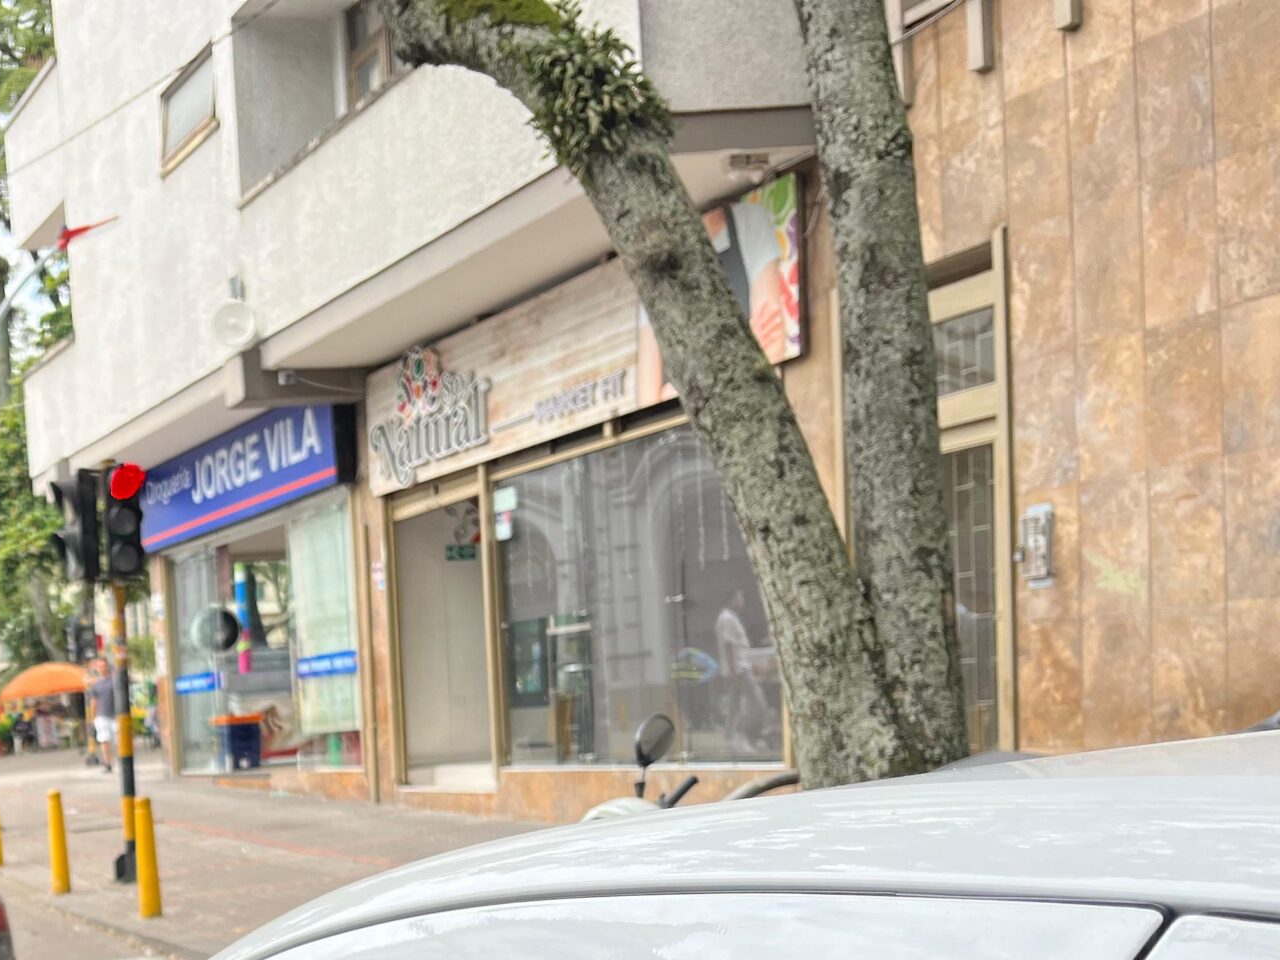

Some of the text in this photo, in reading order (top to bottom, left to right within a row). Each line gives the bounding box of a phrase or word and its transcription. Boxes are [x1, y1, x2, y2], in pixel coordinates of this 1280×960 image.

[192, 432, 262, 504] JORGE
[264, 406, 322, 472] VILA
[371, 377, 489, 487] Natural
